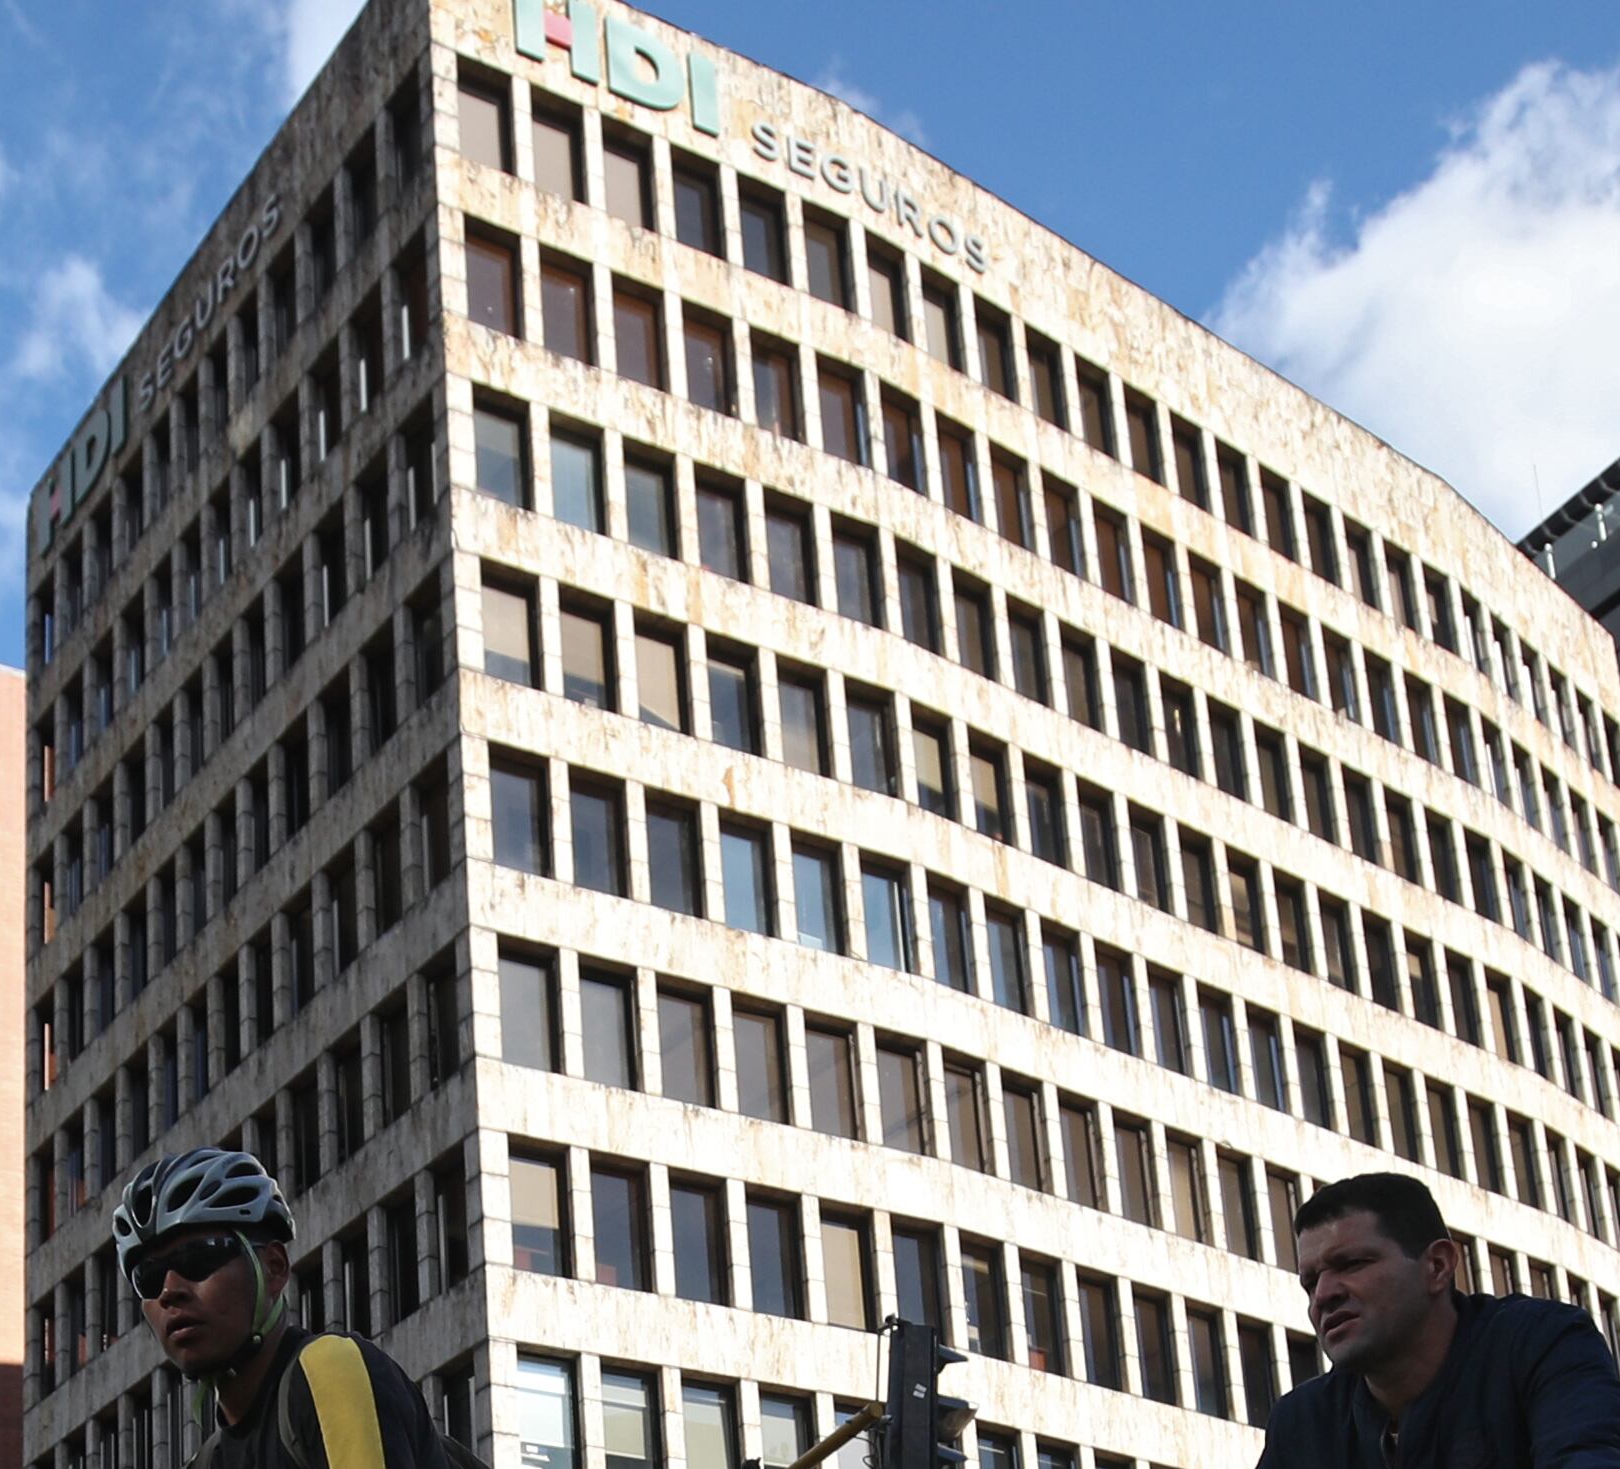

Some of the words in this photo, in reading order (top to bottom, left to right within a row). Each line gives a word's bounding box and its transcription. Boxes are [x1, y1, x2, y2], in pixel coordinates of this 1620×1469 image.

[513, 0, 721, 137] HDI
[751, 120, 991, 275] SEGUROS
[32, 374, 128, 556] HDI
[138, 193, 281, 412] SEGUROS
